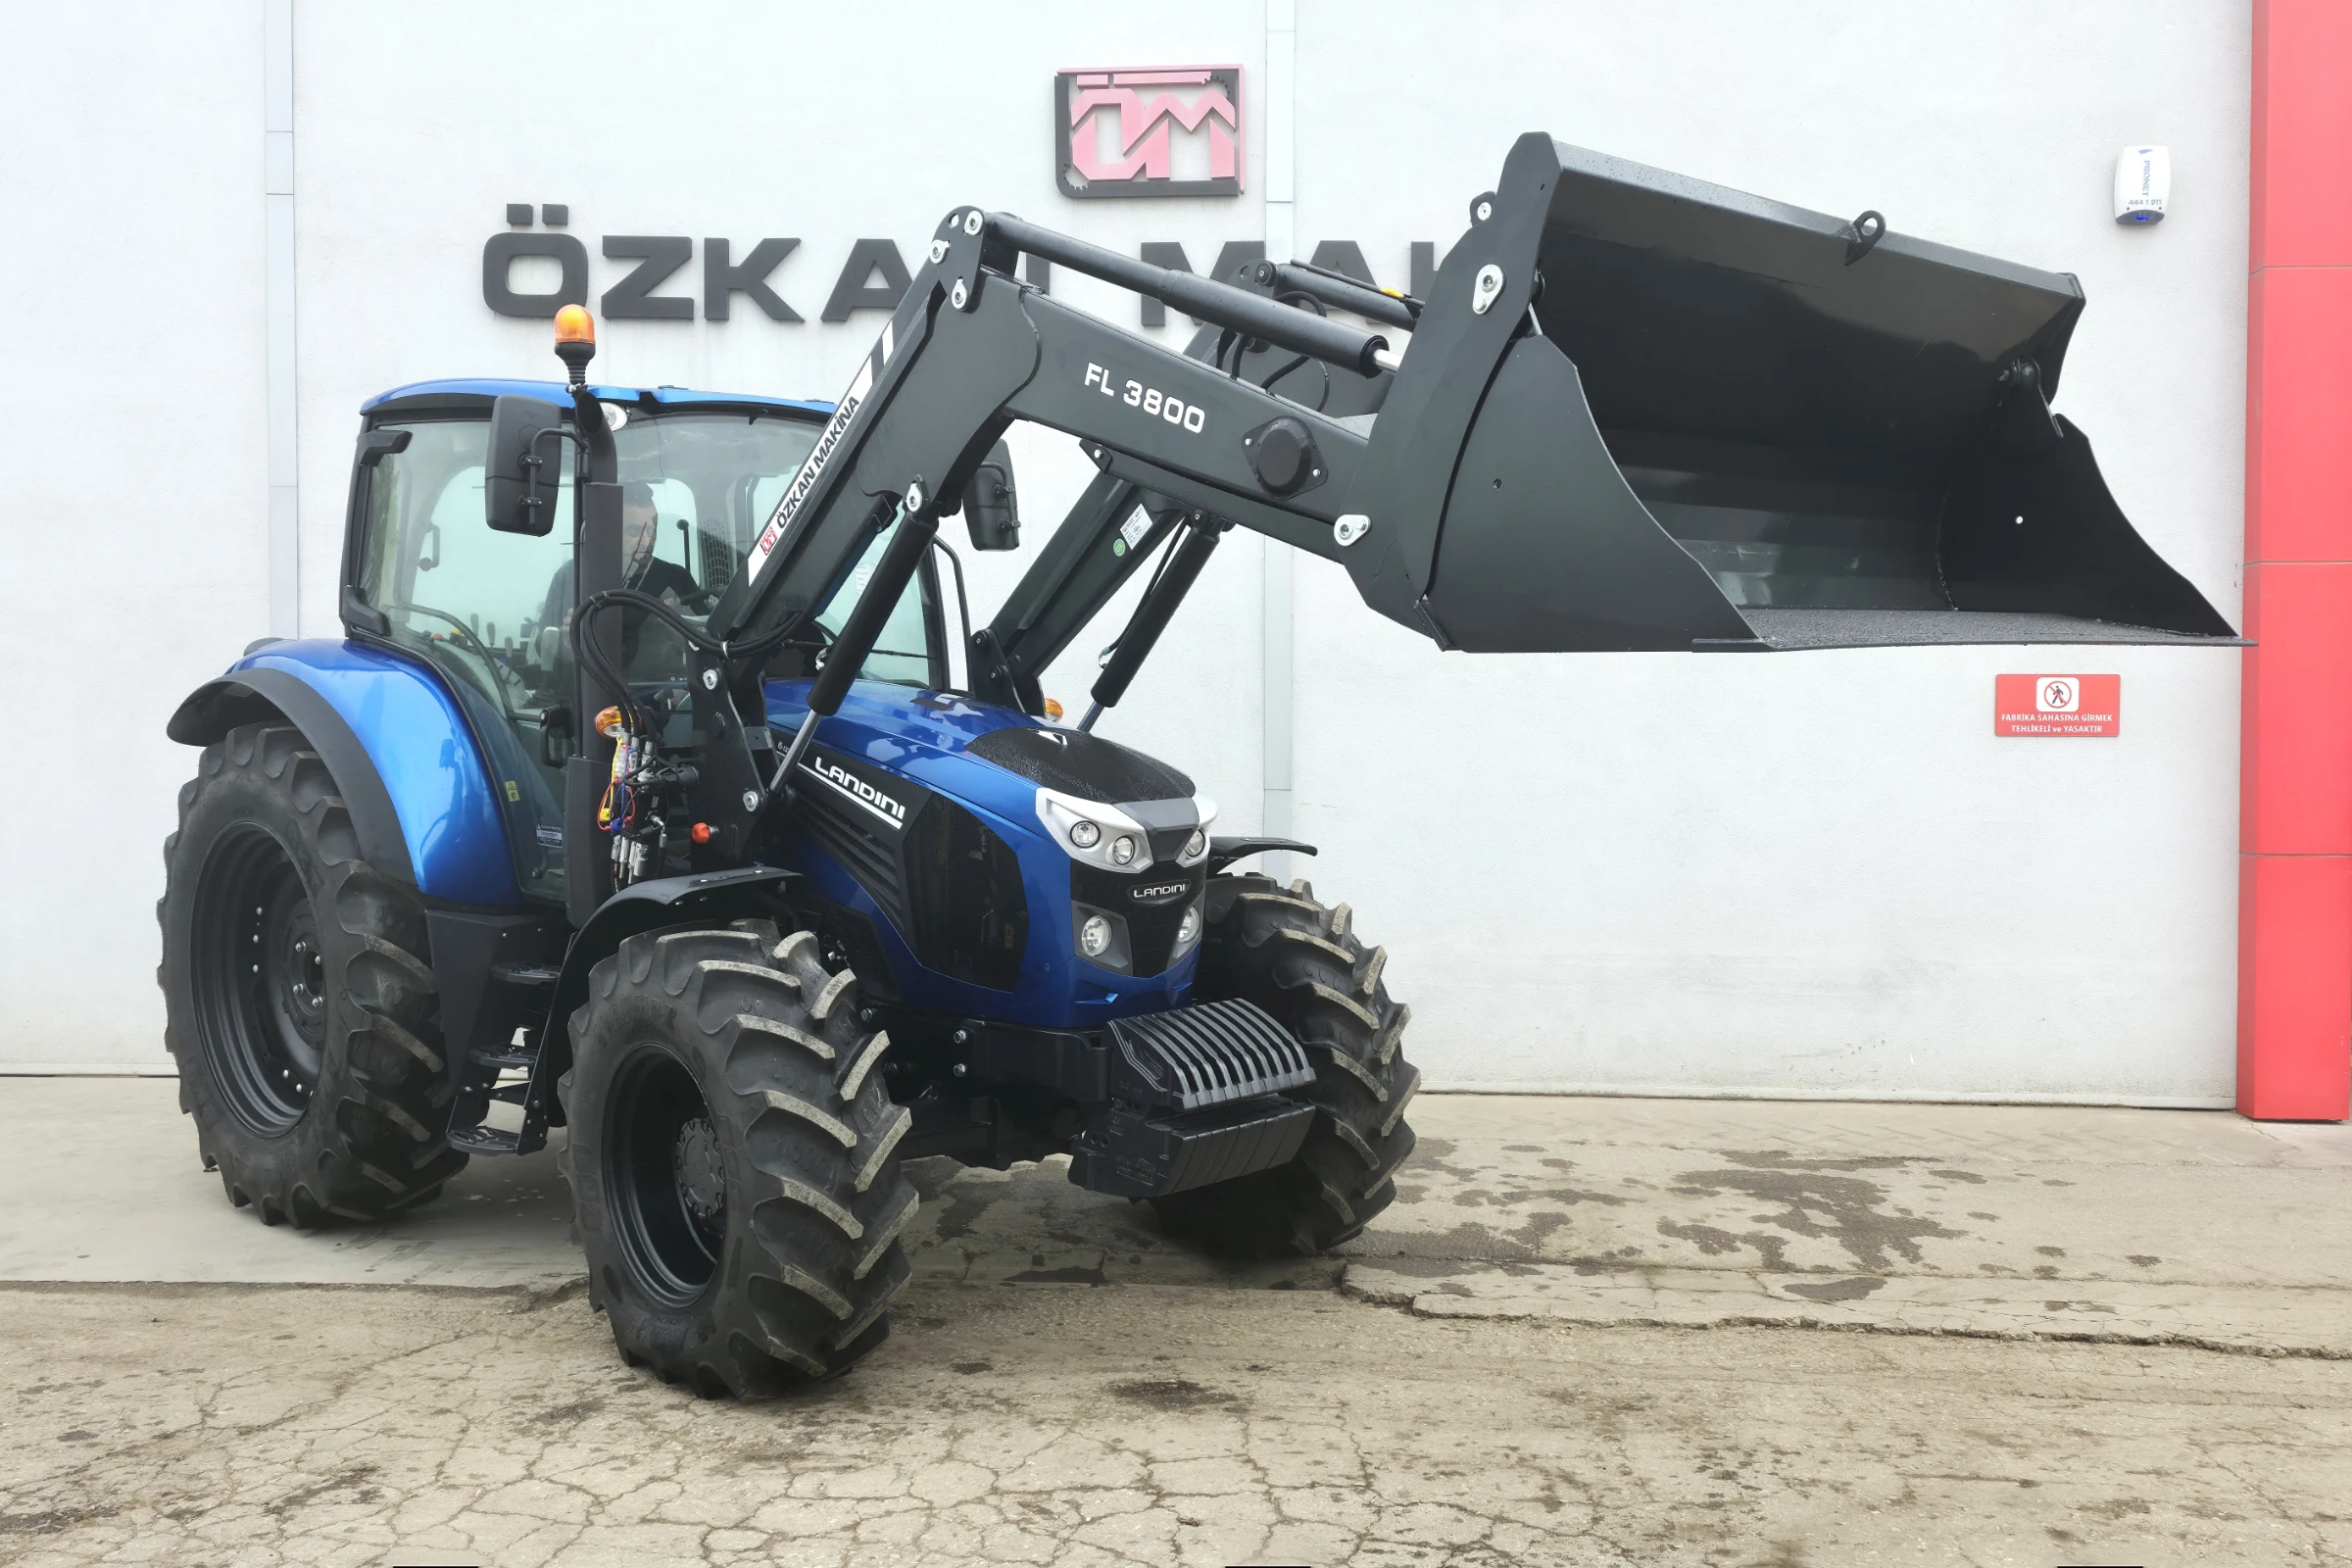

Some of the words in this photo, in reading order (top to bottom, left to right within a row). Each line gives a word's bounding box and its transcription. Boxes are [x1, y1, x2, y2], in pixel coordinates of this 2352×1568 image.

[2142, 160, 2151, 197] PRONET
[482, 203, 1051, 324] ÖZKA
[1084, 362, 1115, 397] FL
[1122, 379, 1205, 434] 3800
[775, 466, 815, 529] ÖZKAN
[812, 396, 859, 470] MAKİNA
[2001, 712, 2035, 722] FABRİKA
[2037, 713, 2080, 722] SAHASINA
[2081, 712, 2113, 722] GİRMEK
[2011, 724, 2051, 733] TEHLİKELİ
[814, 756, 906, 820] LANDINI
[1133, 883, 1187, 899] LANDINI
